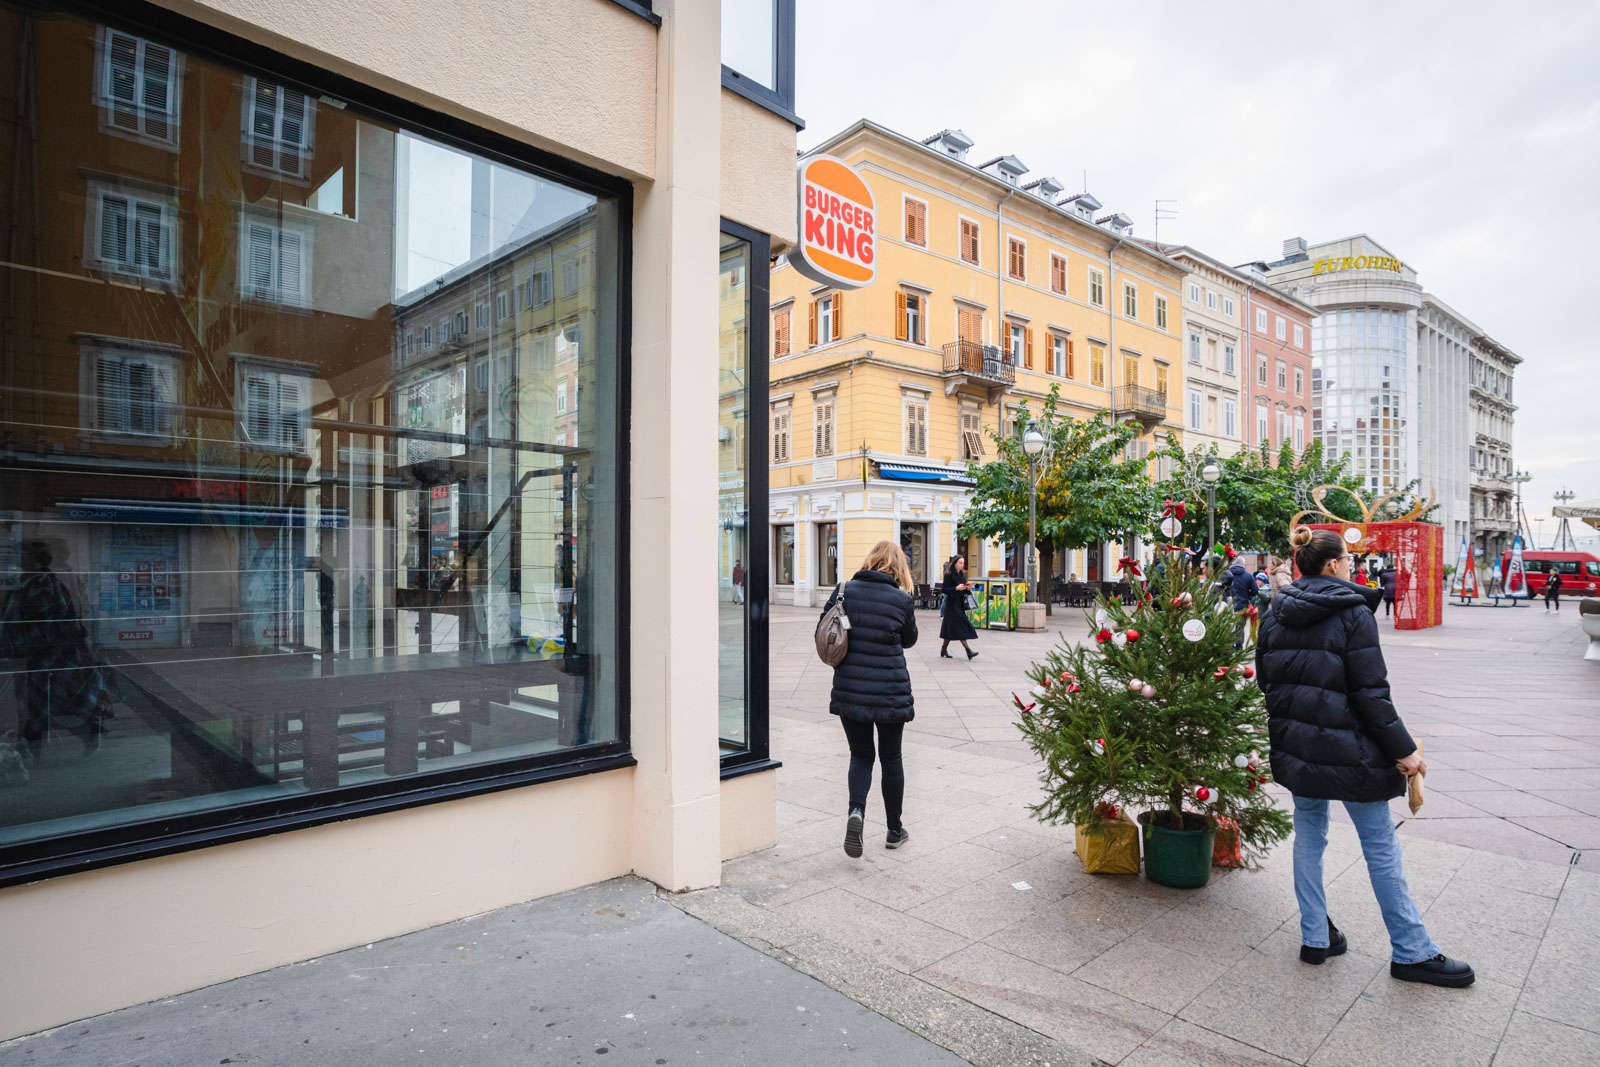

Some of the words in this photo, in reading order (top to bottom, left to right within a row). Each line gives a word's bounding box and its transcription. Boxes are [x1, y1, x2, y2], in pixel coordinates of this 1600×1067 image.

[805, 185, 874, 235] BURGER
[805, 208, 874, 265] KING
[1312, 255, 1404, 274] EUROHERC
